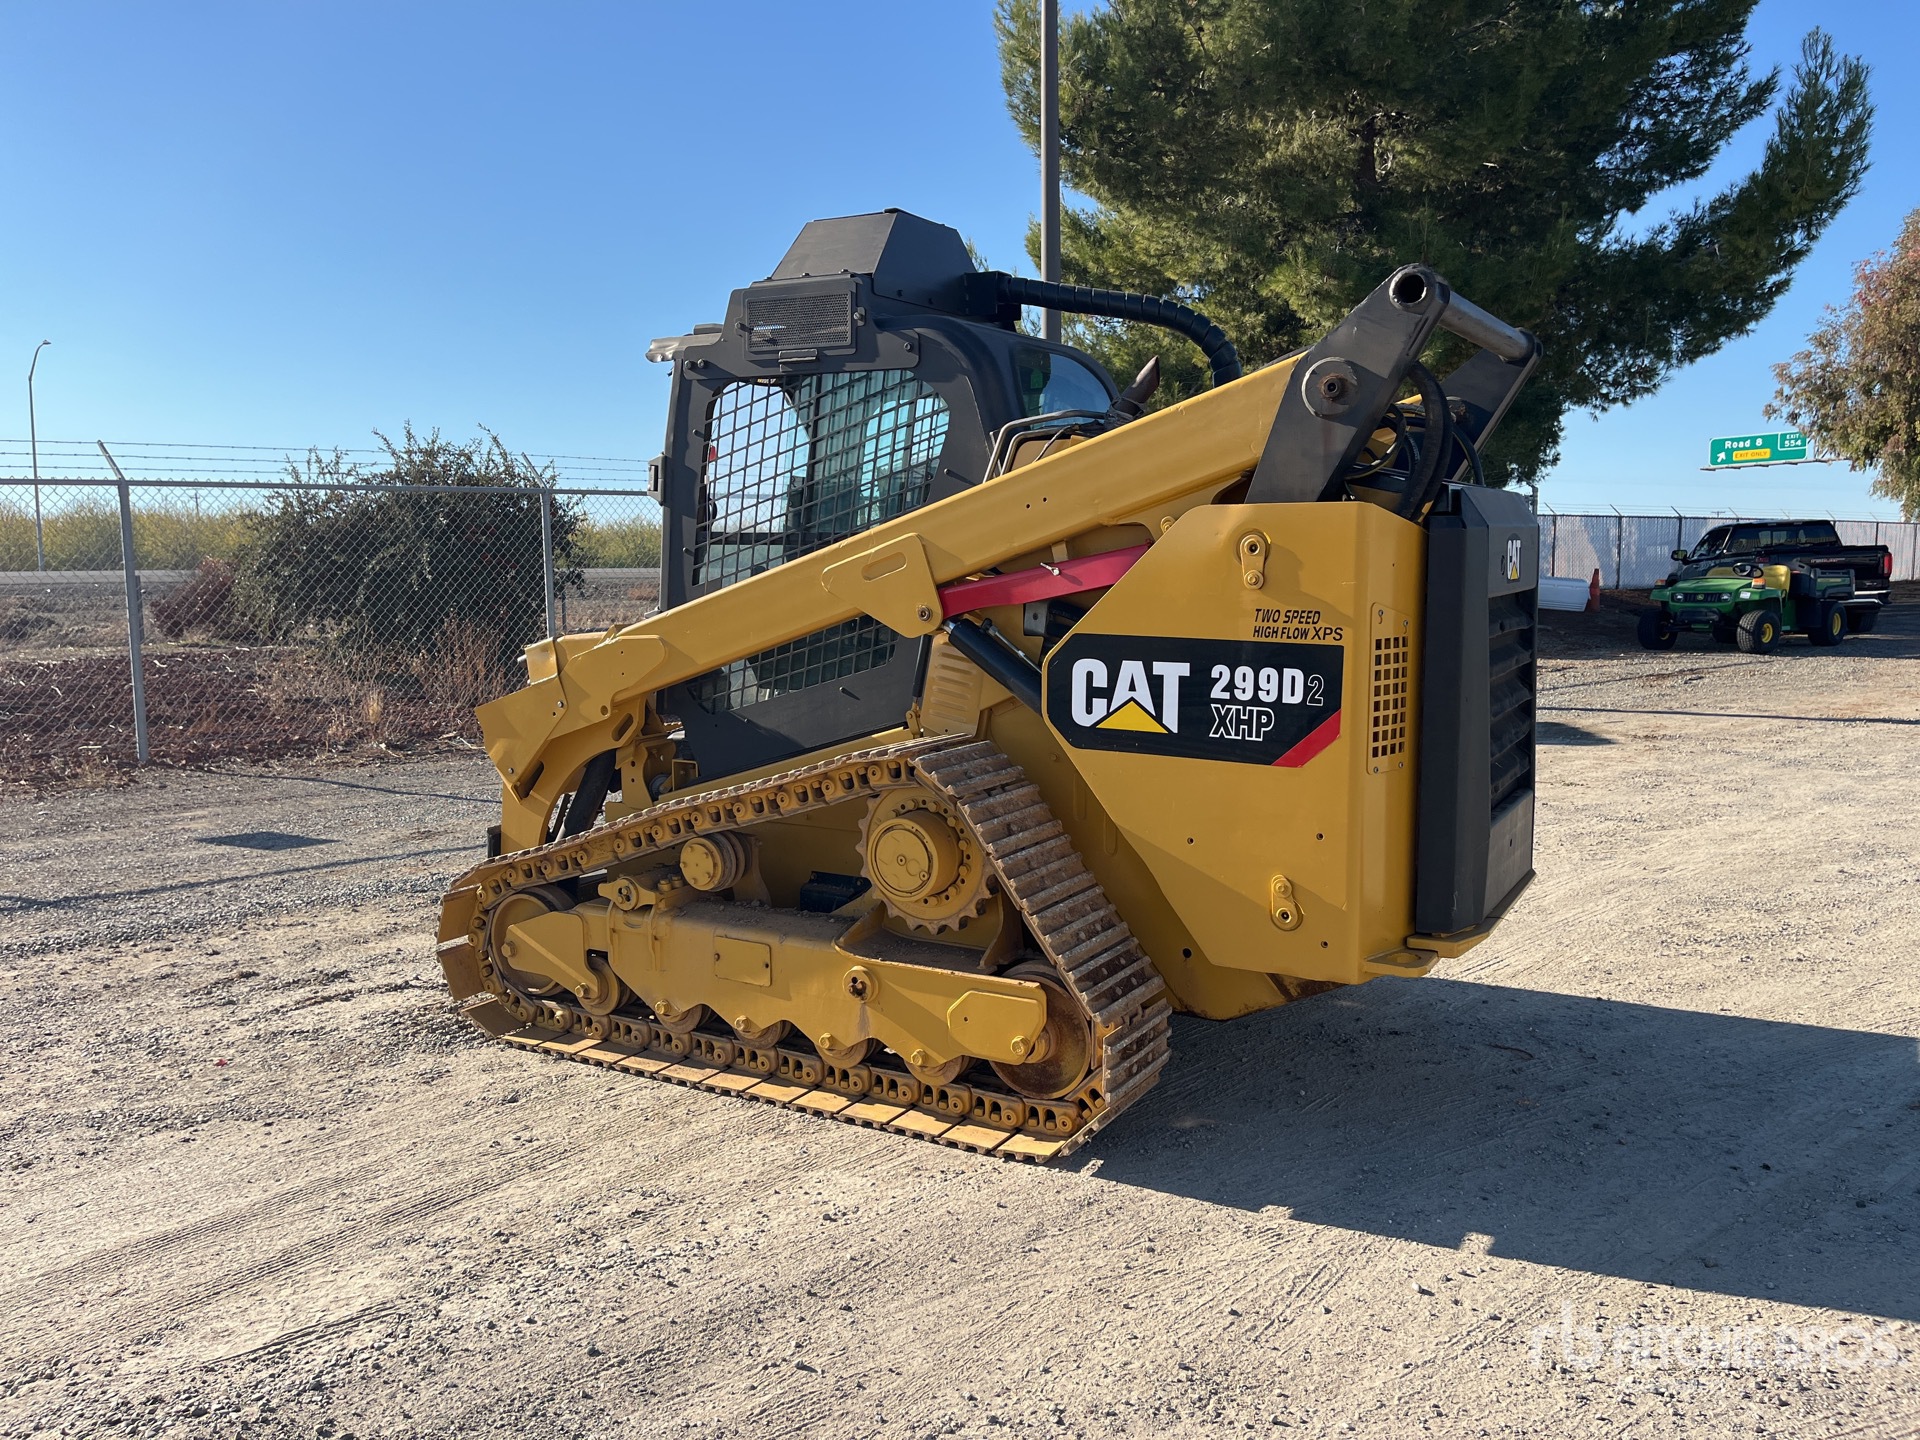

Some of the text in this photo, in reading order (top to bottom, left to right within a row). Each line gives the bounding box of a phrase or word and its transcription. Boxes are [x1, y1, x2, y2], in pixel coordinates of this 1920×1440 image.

[1724, 437, 1763, 449] Road 8
[1784, 439, 1802, 447] 554
[1507, 540, 1521, 580] CAT
[1254, 608, 1321, 625] TWO SPEED
[1252, 625, 1344, 641] HIGH FLOW XPS
[1071, 658, 1191, 734] CAT
[1208, 703, 1275, 742] XHP
